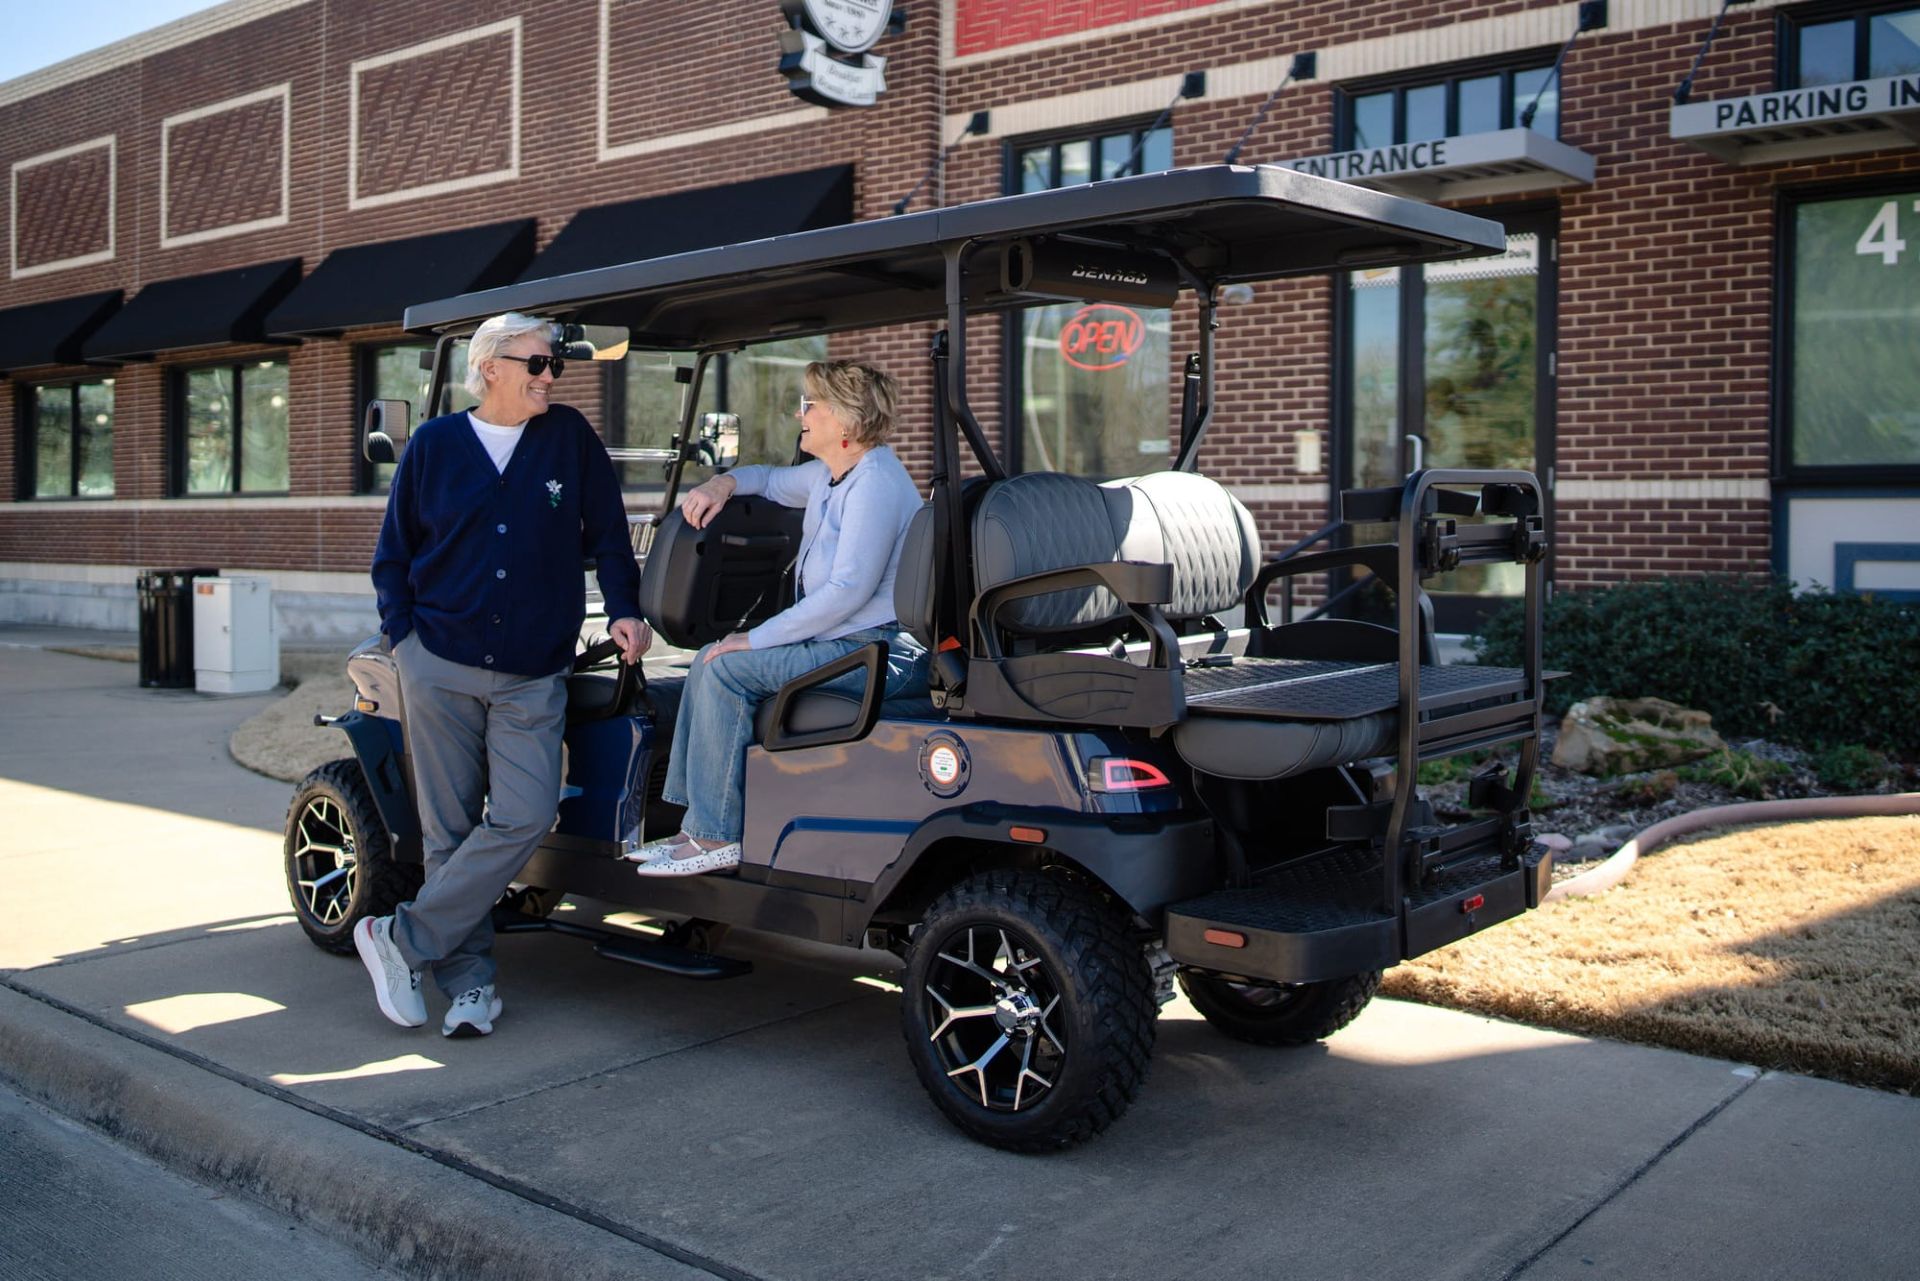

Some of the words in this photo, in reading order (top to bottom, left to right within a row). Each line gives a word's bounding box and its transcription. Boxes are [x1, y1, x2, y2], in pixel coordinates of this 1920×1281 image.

[1716, 85, 1868, 128] PARKING
[1856, 200, 1920, 265] 4
[1066, 320, 1136, 354] OPEN
